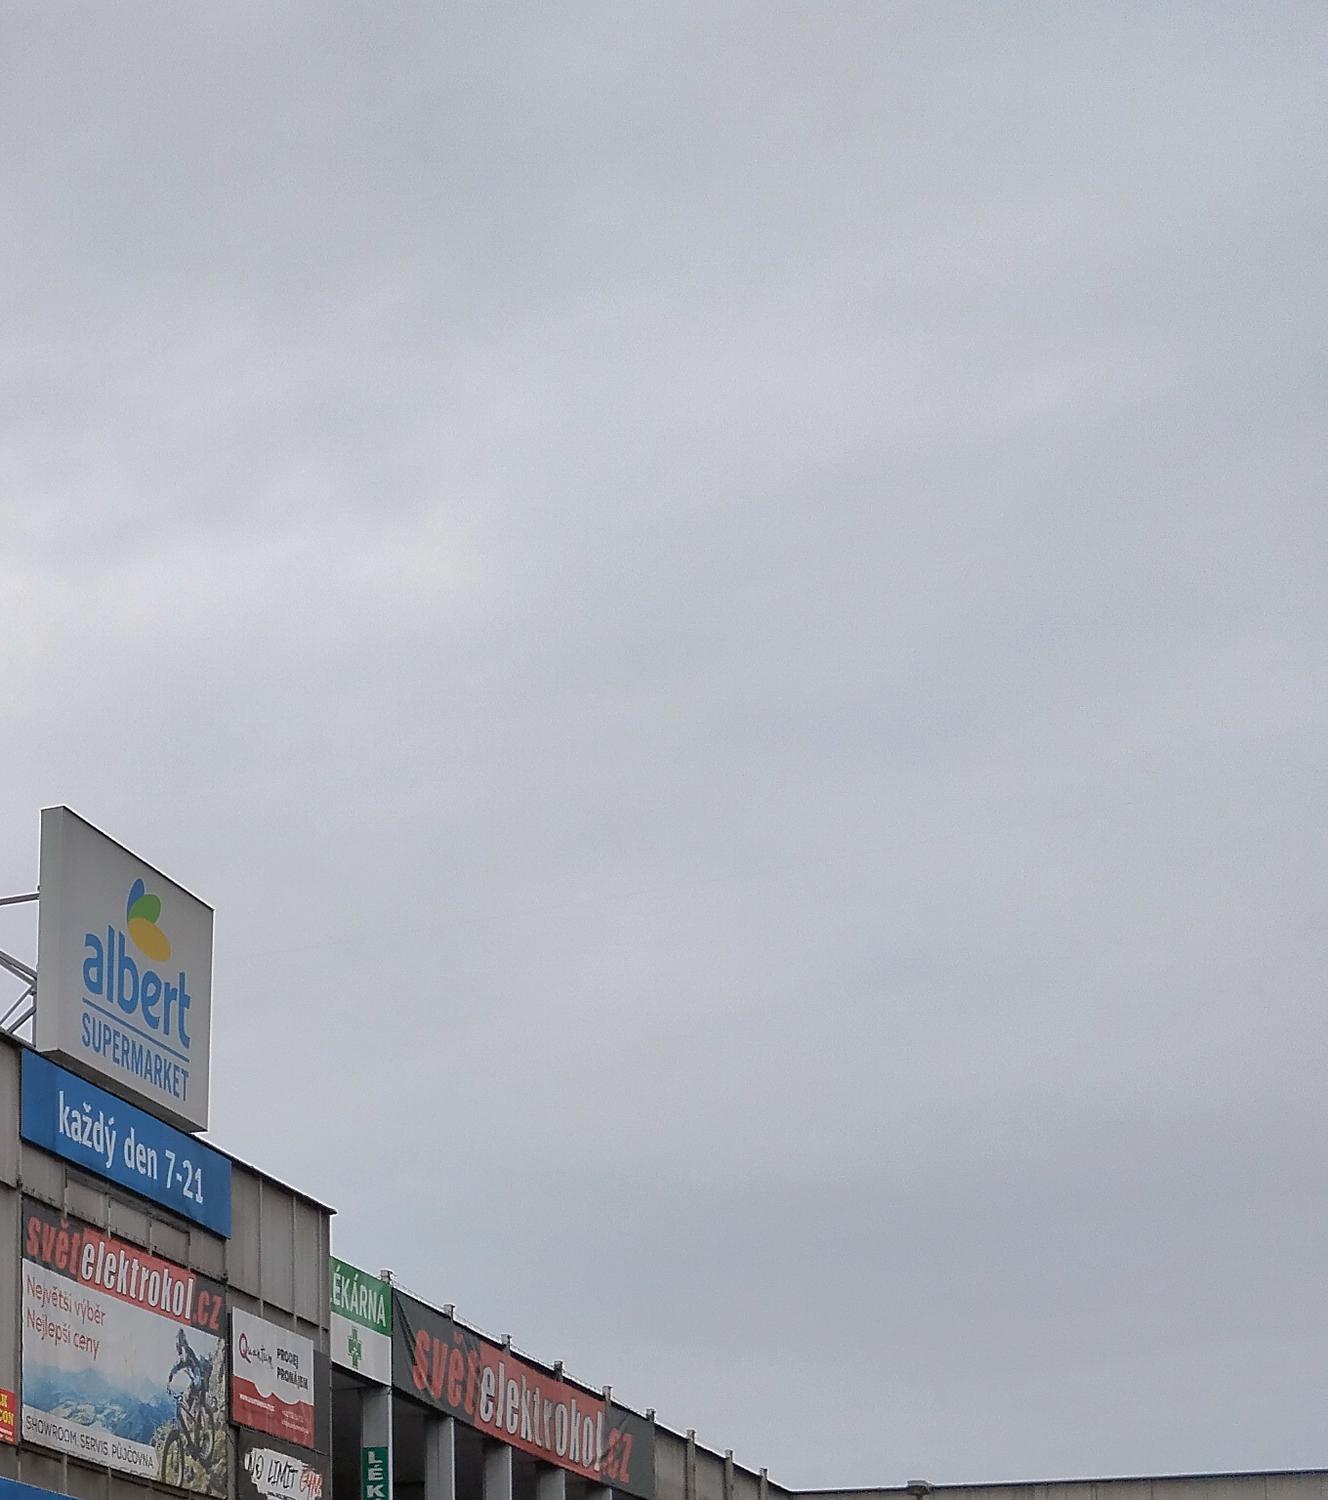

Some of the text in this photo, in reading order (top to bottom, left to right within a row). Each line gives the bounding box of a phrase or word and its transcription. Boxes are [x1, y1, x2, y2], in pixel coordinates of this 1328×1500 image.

[83, 924, 192, 1050] albert
[81, 1011, 190, 1102] SUPERMARKET
[58, 1090, 204, 1204] každý den 7-21
[26, 1274, 72, 1316] Největší
[330, 1264, 387, 1327] ÉKÁRNA
[26, 1308, 101, 1361] Nejlepší ceny
